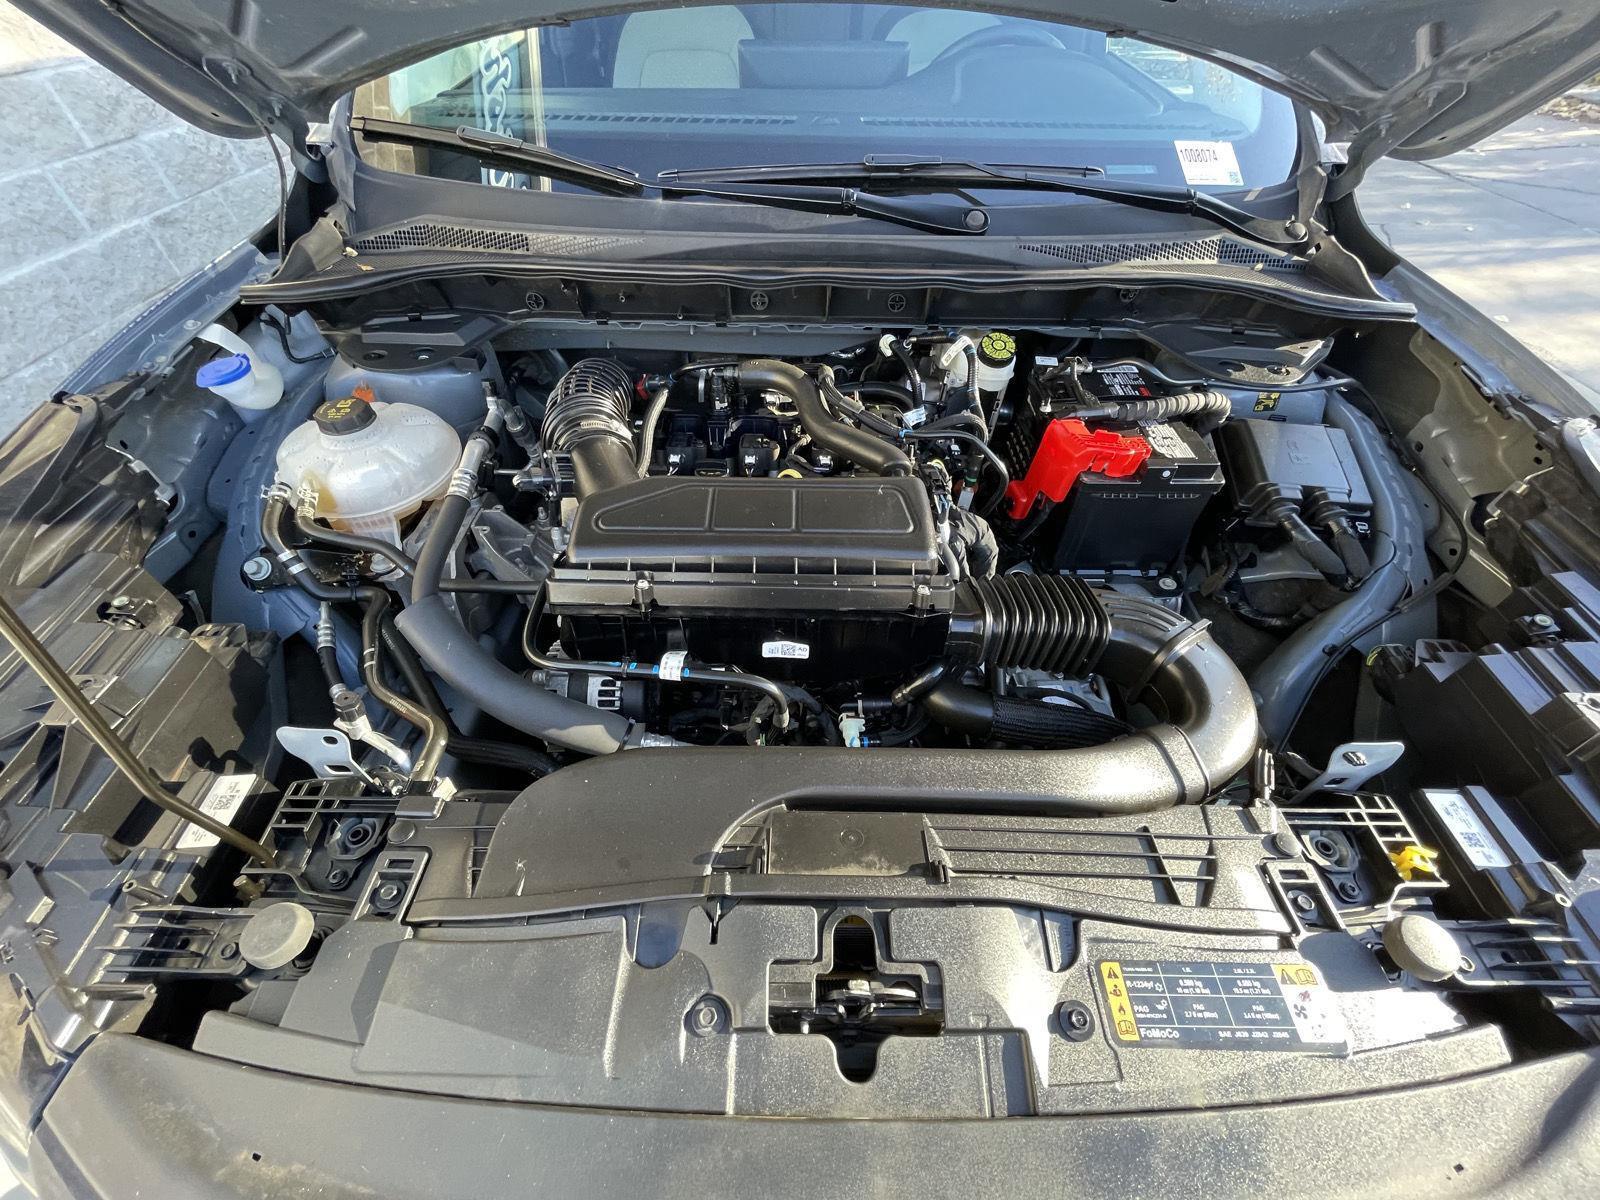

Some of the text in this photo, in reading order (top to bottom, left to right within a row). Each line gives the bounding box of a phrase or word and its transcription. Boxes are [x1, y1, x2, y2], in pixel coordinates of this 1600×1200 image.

[1180, 148, 1218, 163] 1008074
[1126, 980, 1153, 989] R-1234yf
[1140, 1028, 1180, 1038] FoMoCo
